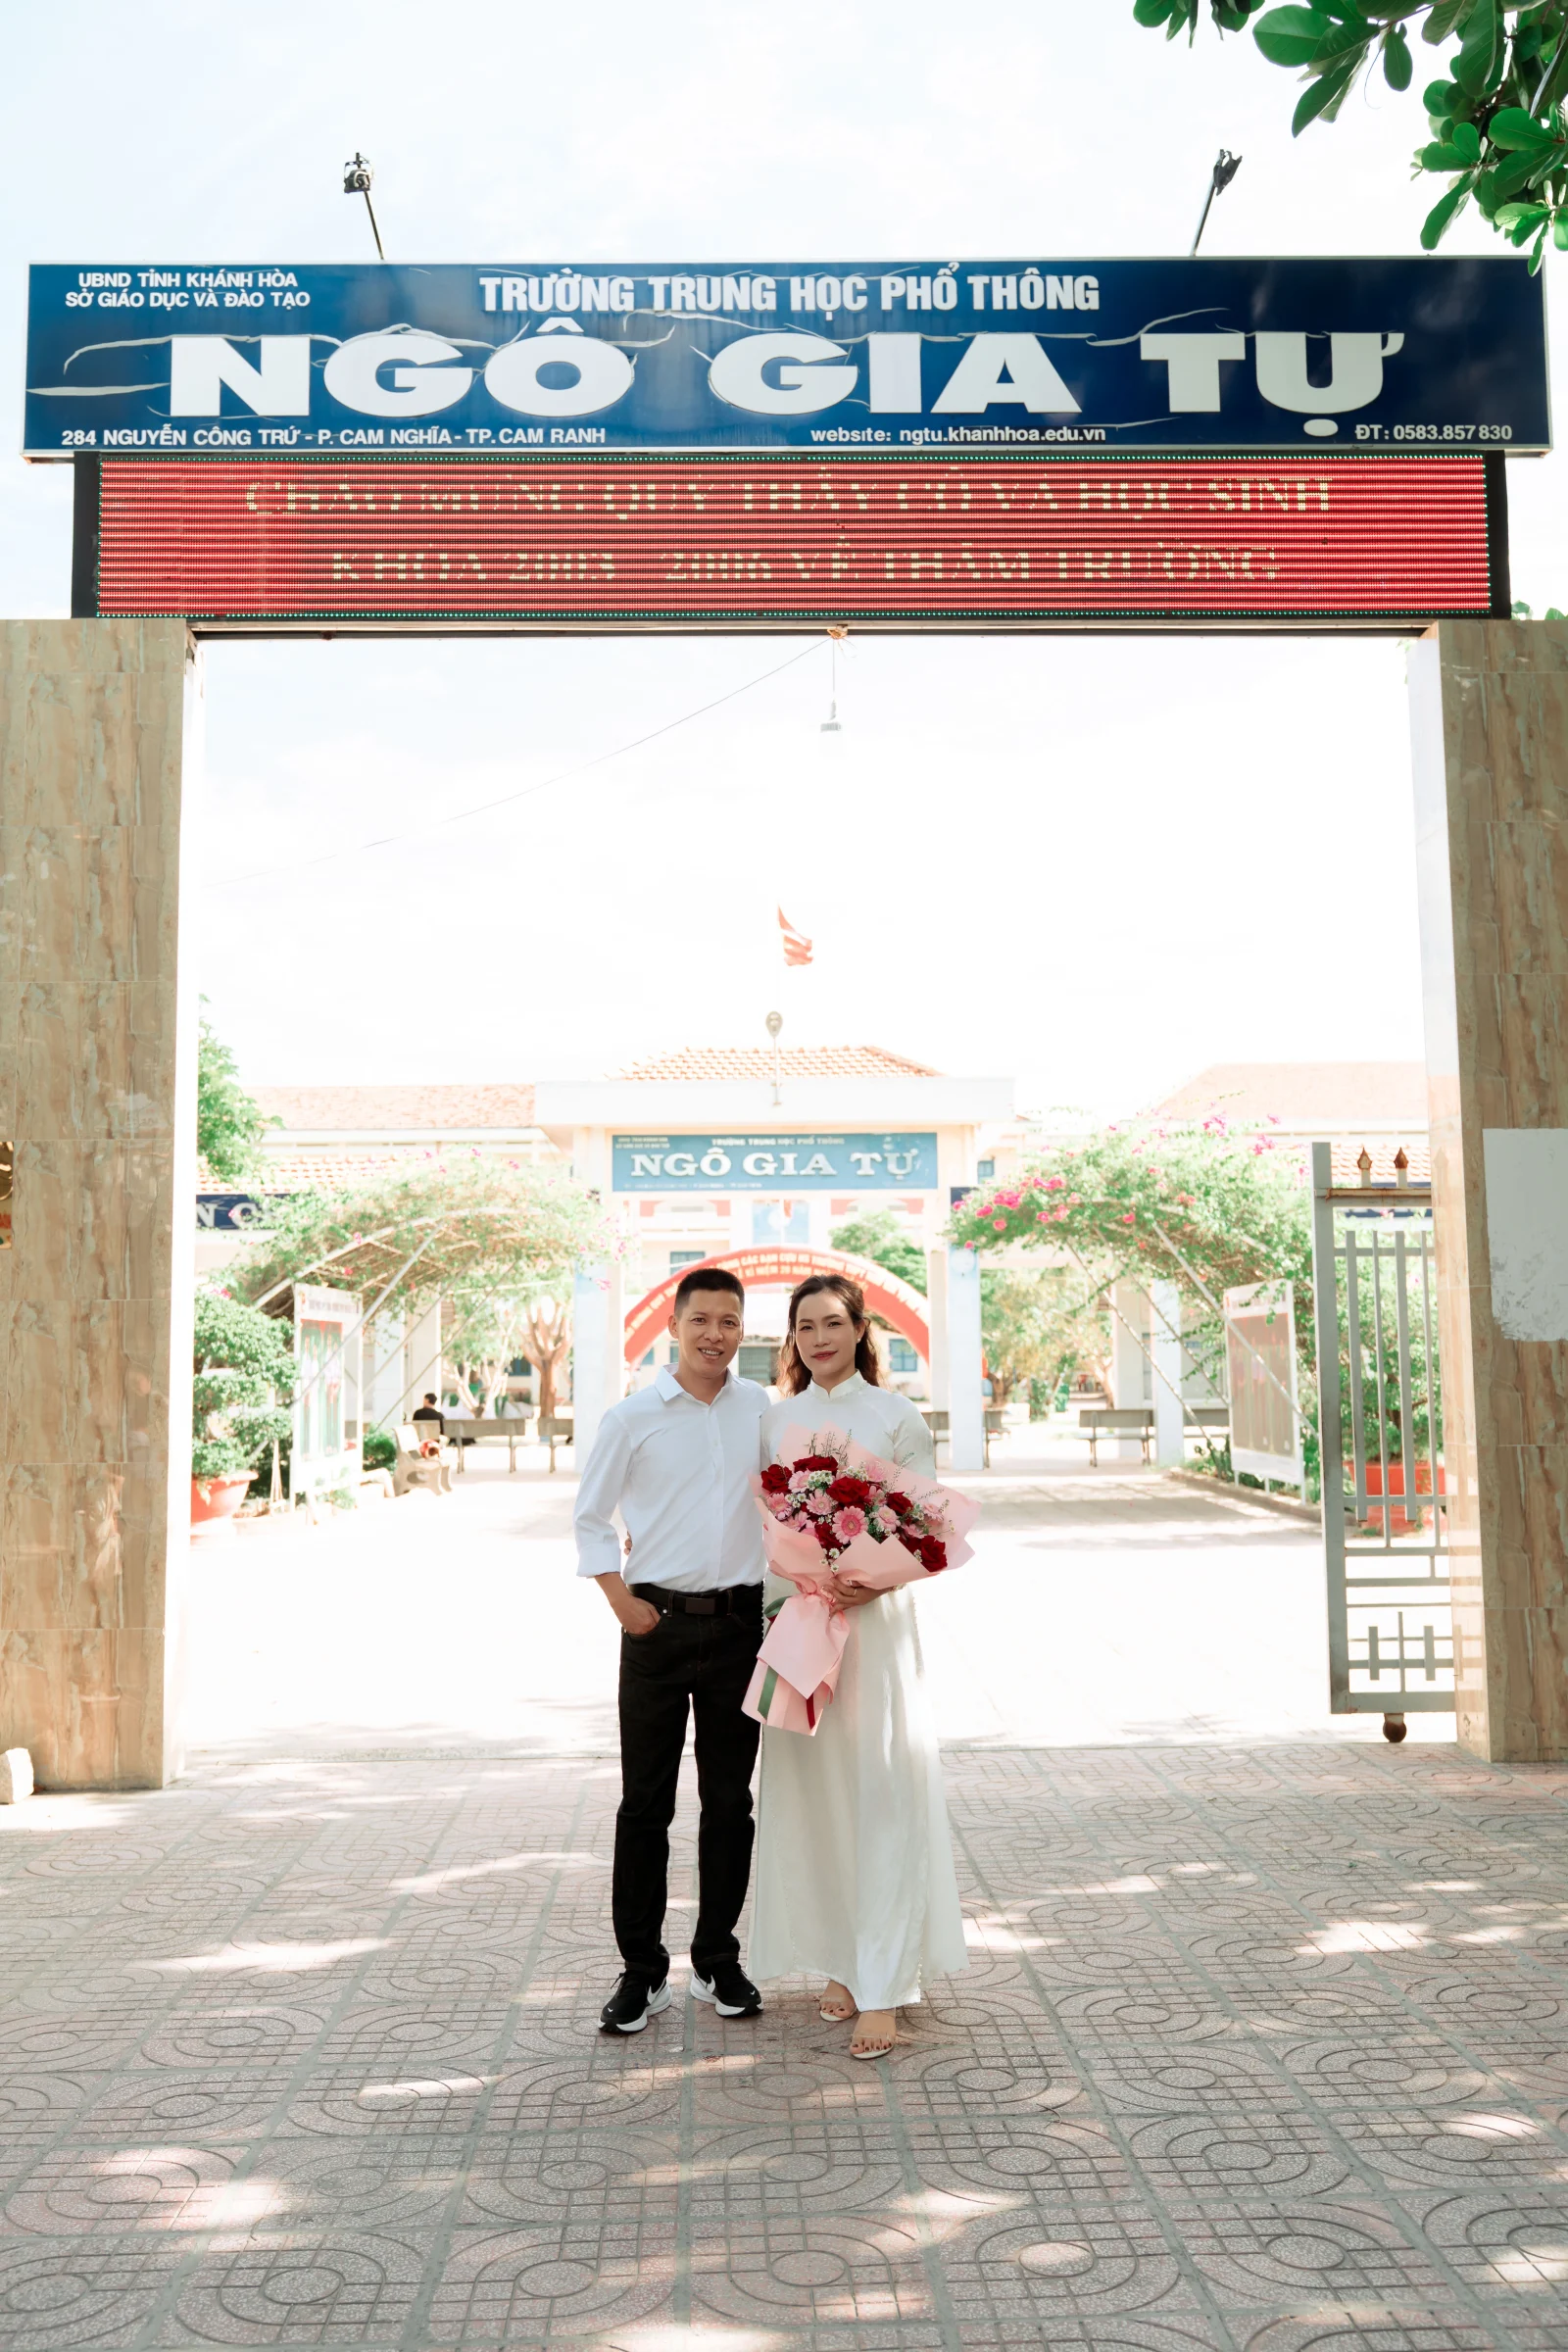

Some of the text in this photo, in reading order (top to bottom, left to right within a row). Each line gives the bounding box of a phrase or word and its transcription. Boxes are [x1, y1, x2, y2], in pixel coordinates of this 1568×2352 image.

[78, 269, 298, 287] UBND TỈNH KHÁNH HÒA
[479, 262, 1101, 320] TRƯỜNG TRUNG HỌC PHỔ THÔNG
[65, 288, 311, 311] SỞ GIÁO DỤC VÀ ĐÀO TẠO
[171, 317, 1405, 437] NGÔ GIA TỰ
[61, 429, 97, 446] 284
[103, 423, 187, 446] NGUYỄN
[193, 425, 252, 446] CÔNG
[258, 425, 302, 445] TRỨ
[318, 429, 333, 445] P.
[339, 429, 383, 445] CAM
[390, 425, 453, 445] NGHĨA
[466, 428, 496, 444] TP.
[499, 428, 543, 444] CAM
[551, 427, 606, 444] RANH
[809, 425, 1106, 445] website: ngtu.khanhhoa.edu.vn
[1208, 478, 1333, 512] SINH
[630, 1147, 919, 1181] NGÔ GIA TỰ
